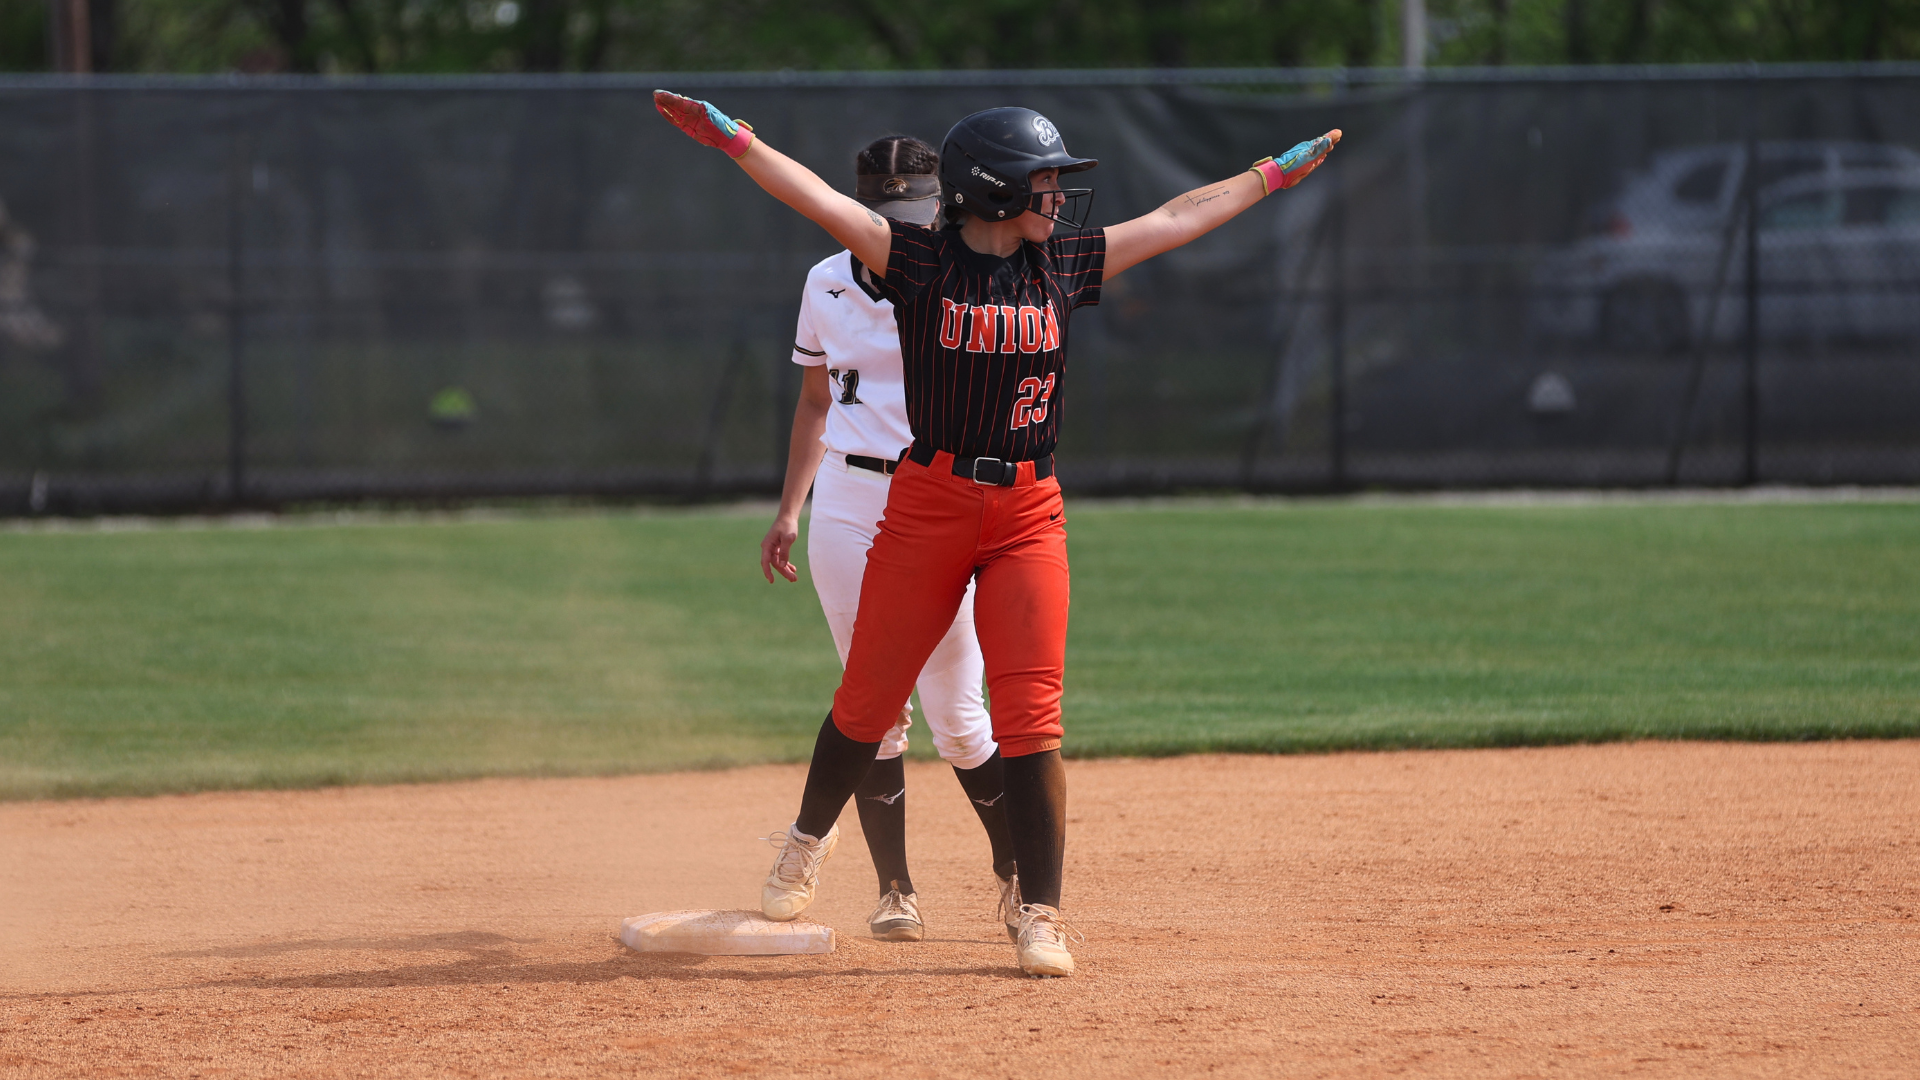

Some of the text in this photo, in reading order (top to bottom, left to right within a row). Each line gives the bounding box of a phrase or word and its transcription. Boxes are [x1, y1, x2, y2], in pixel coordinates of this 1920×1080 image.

[979, 172, 1006, 188] RIP-IT
[940, 298, 1060, 354] UNION
[1010, 372, 1056, 430] 23
